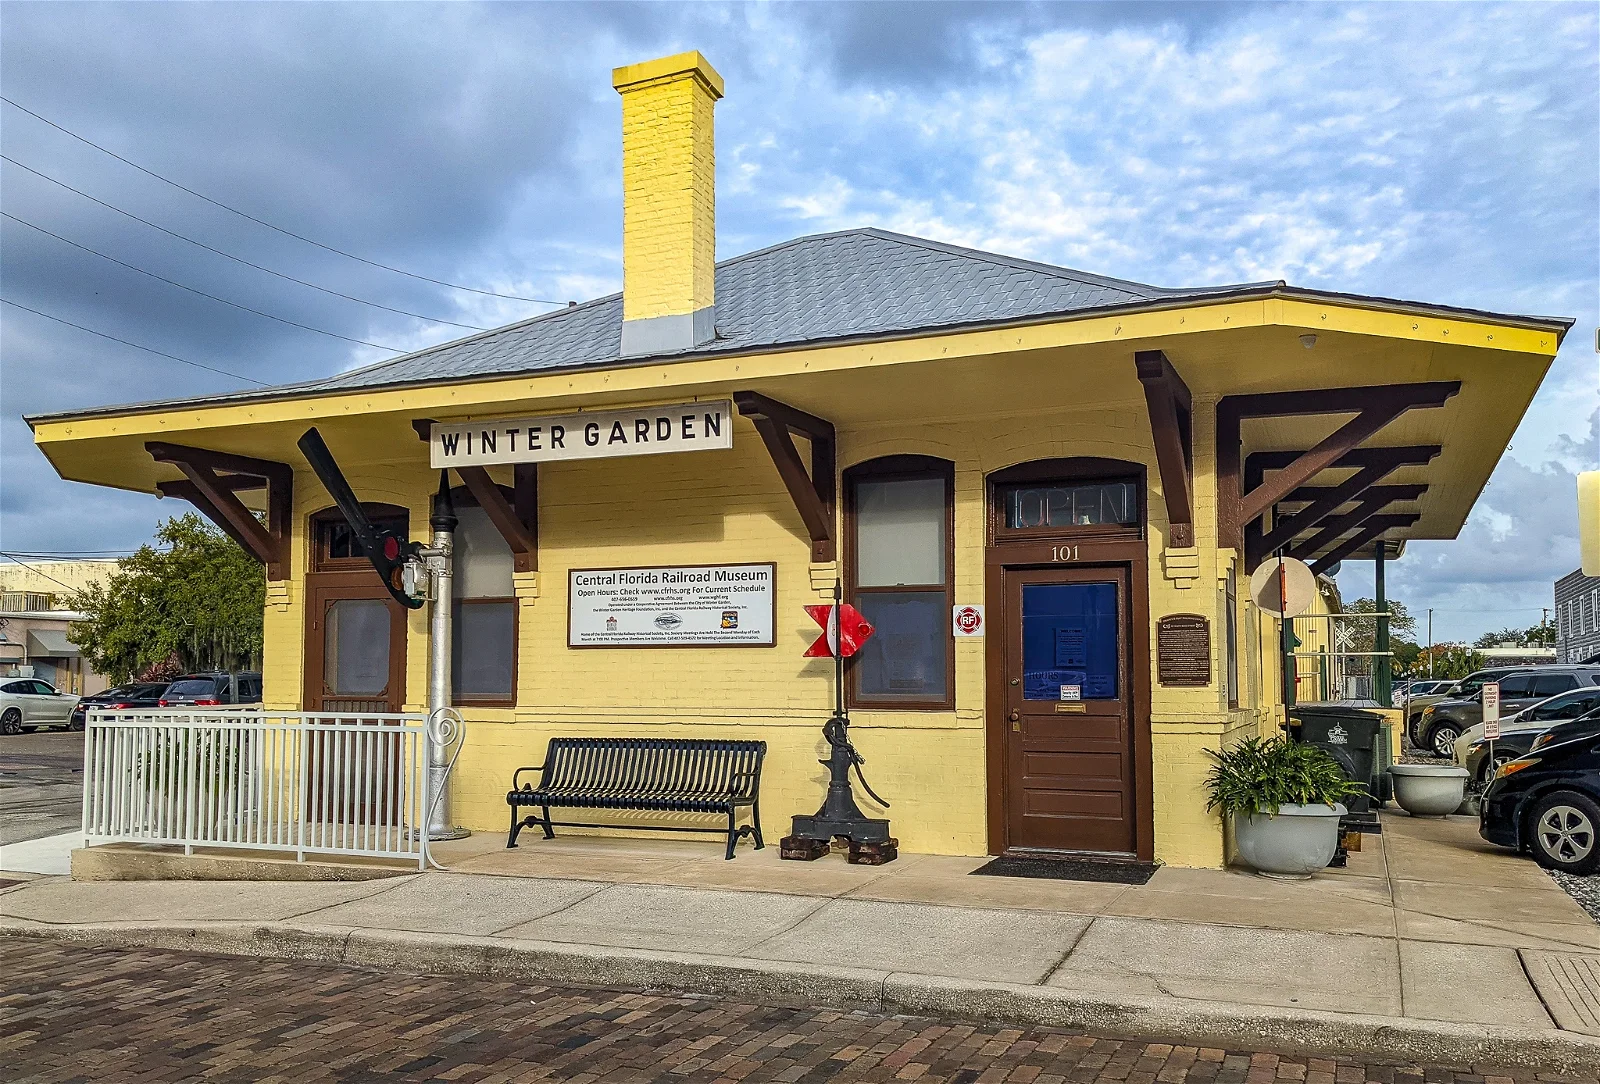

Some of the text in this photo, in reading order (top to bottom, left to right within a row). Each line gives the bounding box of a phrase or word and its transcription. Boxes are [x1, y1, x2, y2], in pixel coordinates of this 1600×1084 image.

[441, 412, 721, 457] WINTER GARDEN
[1019, 487, 1124, 526] OPEN
[1051, 545, 1080, 562] 101
[575, 570, 768, 586] Central Florida Railroad Museum
[577, 584, 766, 598] Open Hours: Check www.cfrhs.org For Current Schedule
[962, 616, 975, 625] RF
[1028, 672, 1059, 680] HOURS
